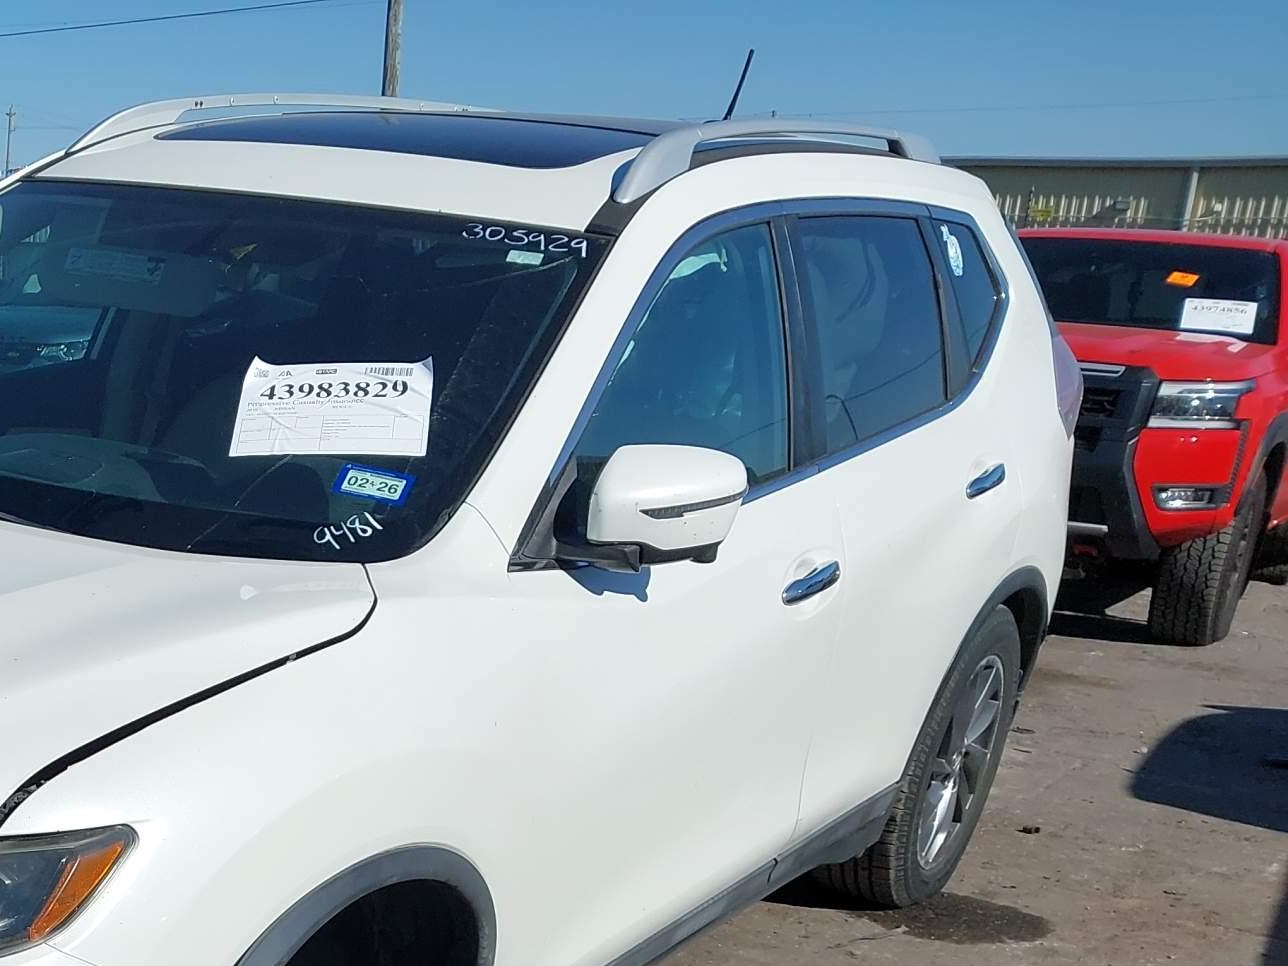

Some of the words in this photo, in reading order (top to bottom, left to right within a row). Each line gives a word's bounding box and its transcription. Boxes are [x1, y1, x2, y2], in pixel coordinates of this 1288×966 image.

[260, 379, 409, 400] 43983829
[347, 475, 369, 489] 02
[376, 481, 400, 494] 26
